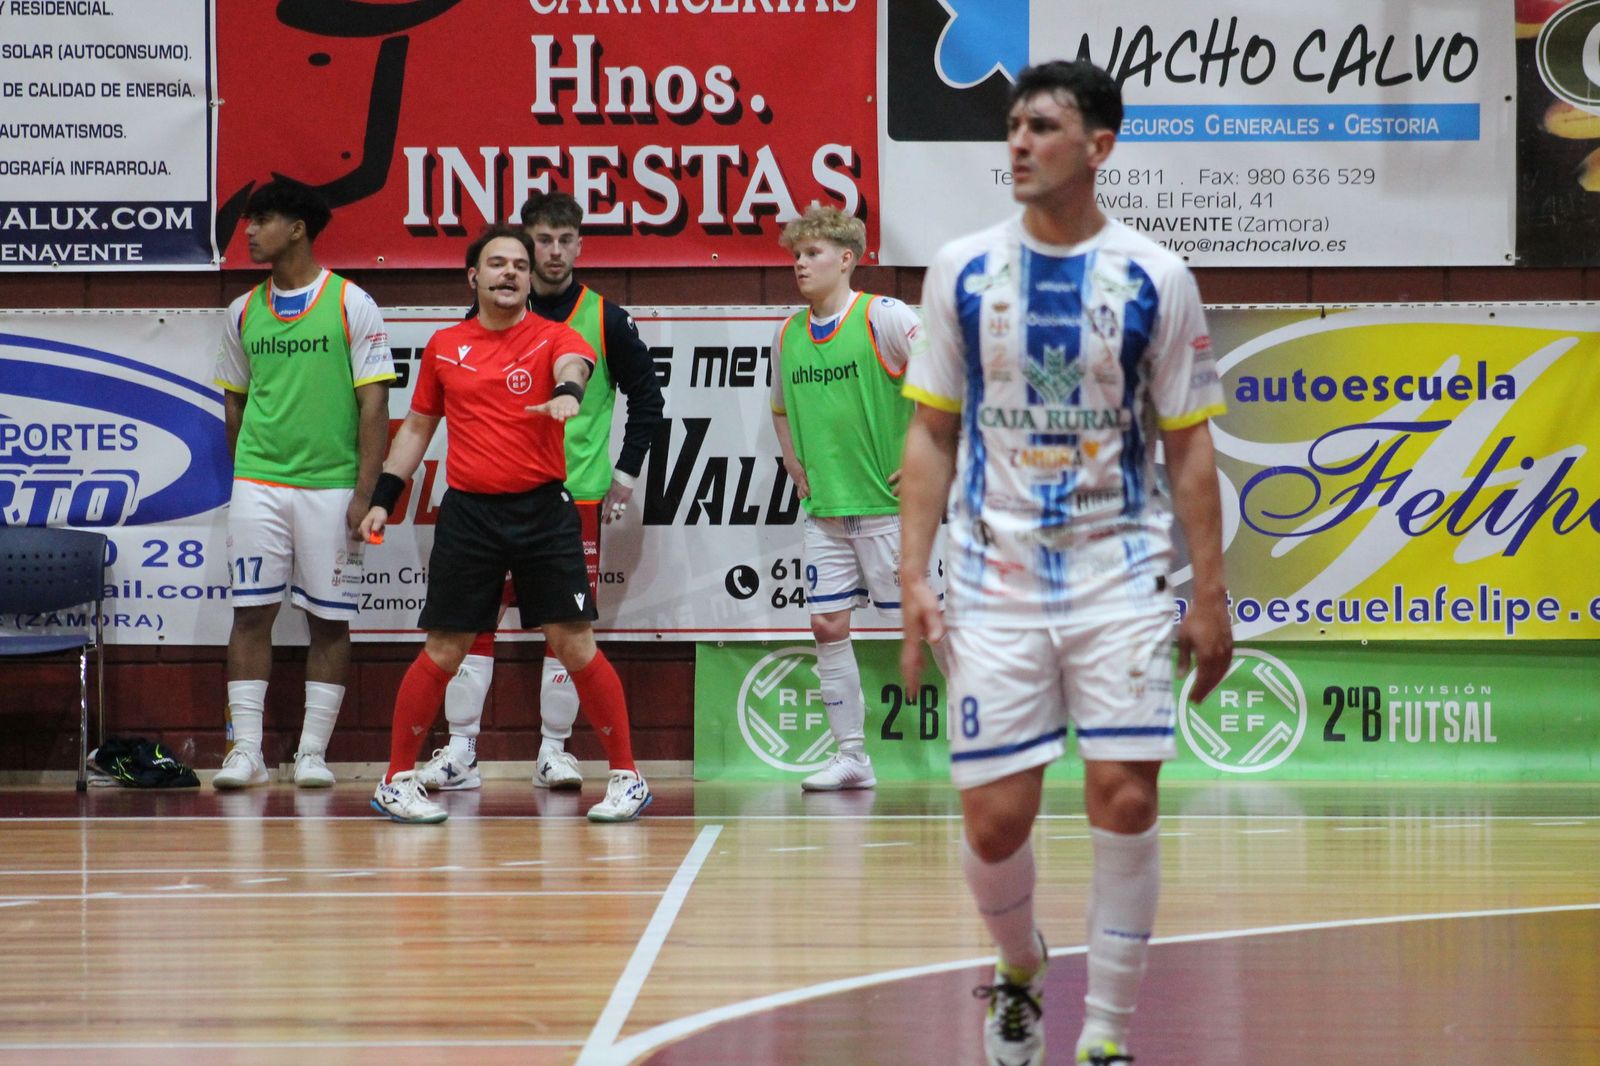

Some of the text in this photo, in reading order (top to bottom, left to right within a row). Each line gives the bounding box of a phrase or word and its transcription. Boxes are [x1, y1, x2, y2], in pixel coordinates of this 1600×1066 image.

[11, 1, 114, 16] RESIDENCIAL.
[2, 44, 192, 61] SOLAR (AUTOCONSUMO).
[1293, 24, 1479, 93] CALVO
[531, 35, 765, 114] Hnos.
[4, 79, 196, 98] DE CALIDAD DE ENERGÍA.
[0, 124, 127, 139] AUTOMATISMOS.
[1120, 114, 1440, 135] EGUROS GENERALES GESTORIA
[0, 156, 171, 176] OGRAFÍA INFRARROJA.
[403, 144, 860, 226] INFESTAS
[991, 168, 1376, 185] Te 30 811 Fax: 980 636 529
[1096, 191, 1274, 211] Avda. El Ferial, 41
[0, 207, 193, 230] ALUX.COM
[1123, 215, 1330, 233] ENAVENTE (Zamora)
[1, 243, 143, 261] ENAVENTE
[251, 335, 330, 358] uhlsport
[791, 360, 859, 385] uhlsport
[1235, 361, 1516, 402] autoescuela
[979, 407, 1035, 430] CAJA
[0, 423, 139, 451] PORTES
[235, 557, 263, 584] 17
[399, 567, 430, 584] Cri
[103, 580, 232, 599] ail.com
[15, 613, 164, 632] (ZAMORA)
[1220, 690, 1265, 708] RF
[1389, 683, 1492, 695] DIVISIÓN
[960, 696, 980, 738] 8
[1220, 715, 1265, 732] EF
[1389, 701, 1498, 743] FUTSAL
